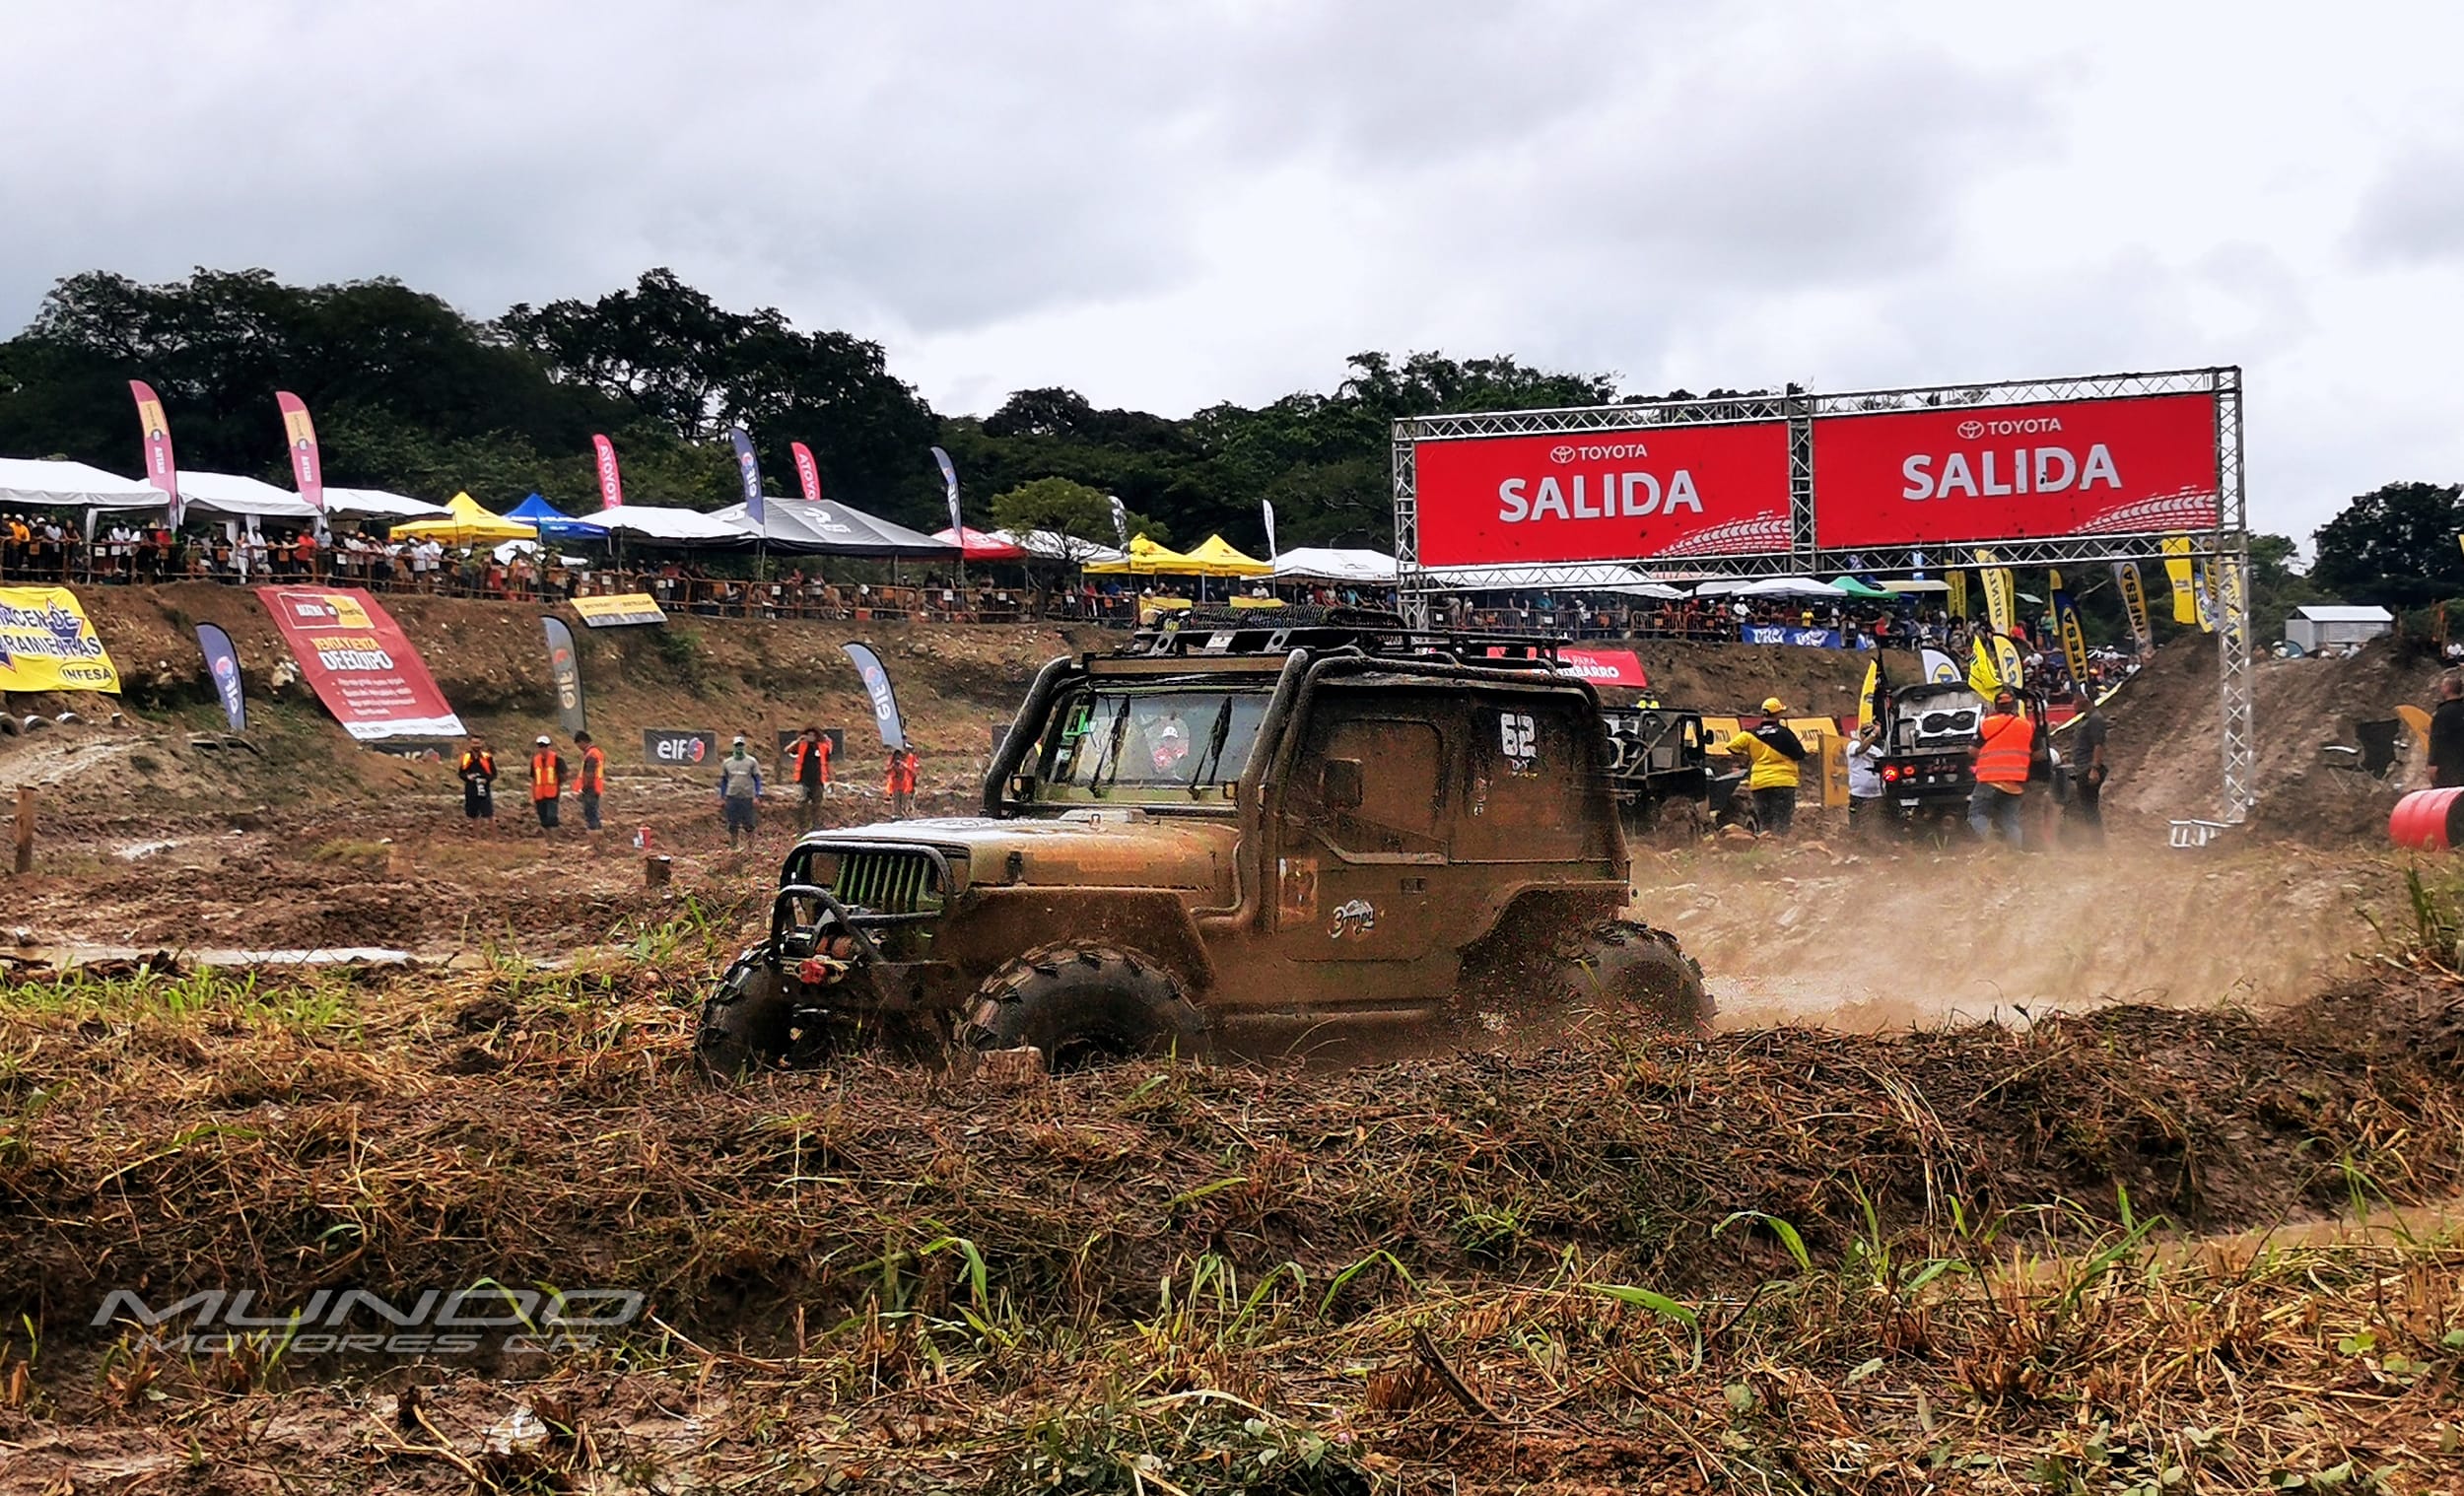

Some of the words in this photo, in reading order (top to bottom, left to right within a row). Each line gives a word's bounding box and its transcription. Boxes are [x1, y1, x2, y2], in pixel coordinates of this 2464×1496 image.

[1987, 418, 2062, 436] TOYOTA
[1578, 443, 1647, 460] TOYOTA
[1902, 443, 2122, 501] SALIDA
[1499, 469, 1703, 522] SALIDA
[2123, 570, 2145, 633] INFESA
[62, 668, 112, 681] INFESA
[657, 739, 688, 760] elf
[1500, 713, 1537, 758] 62
